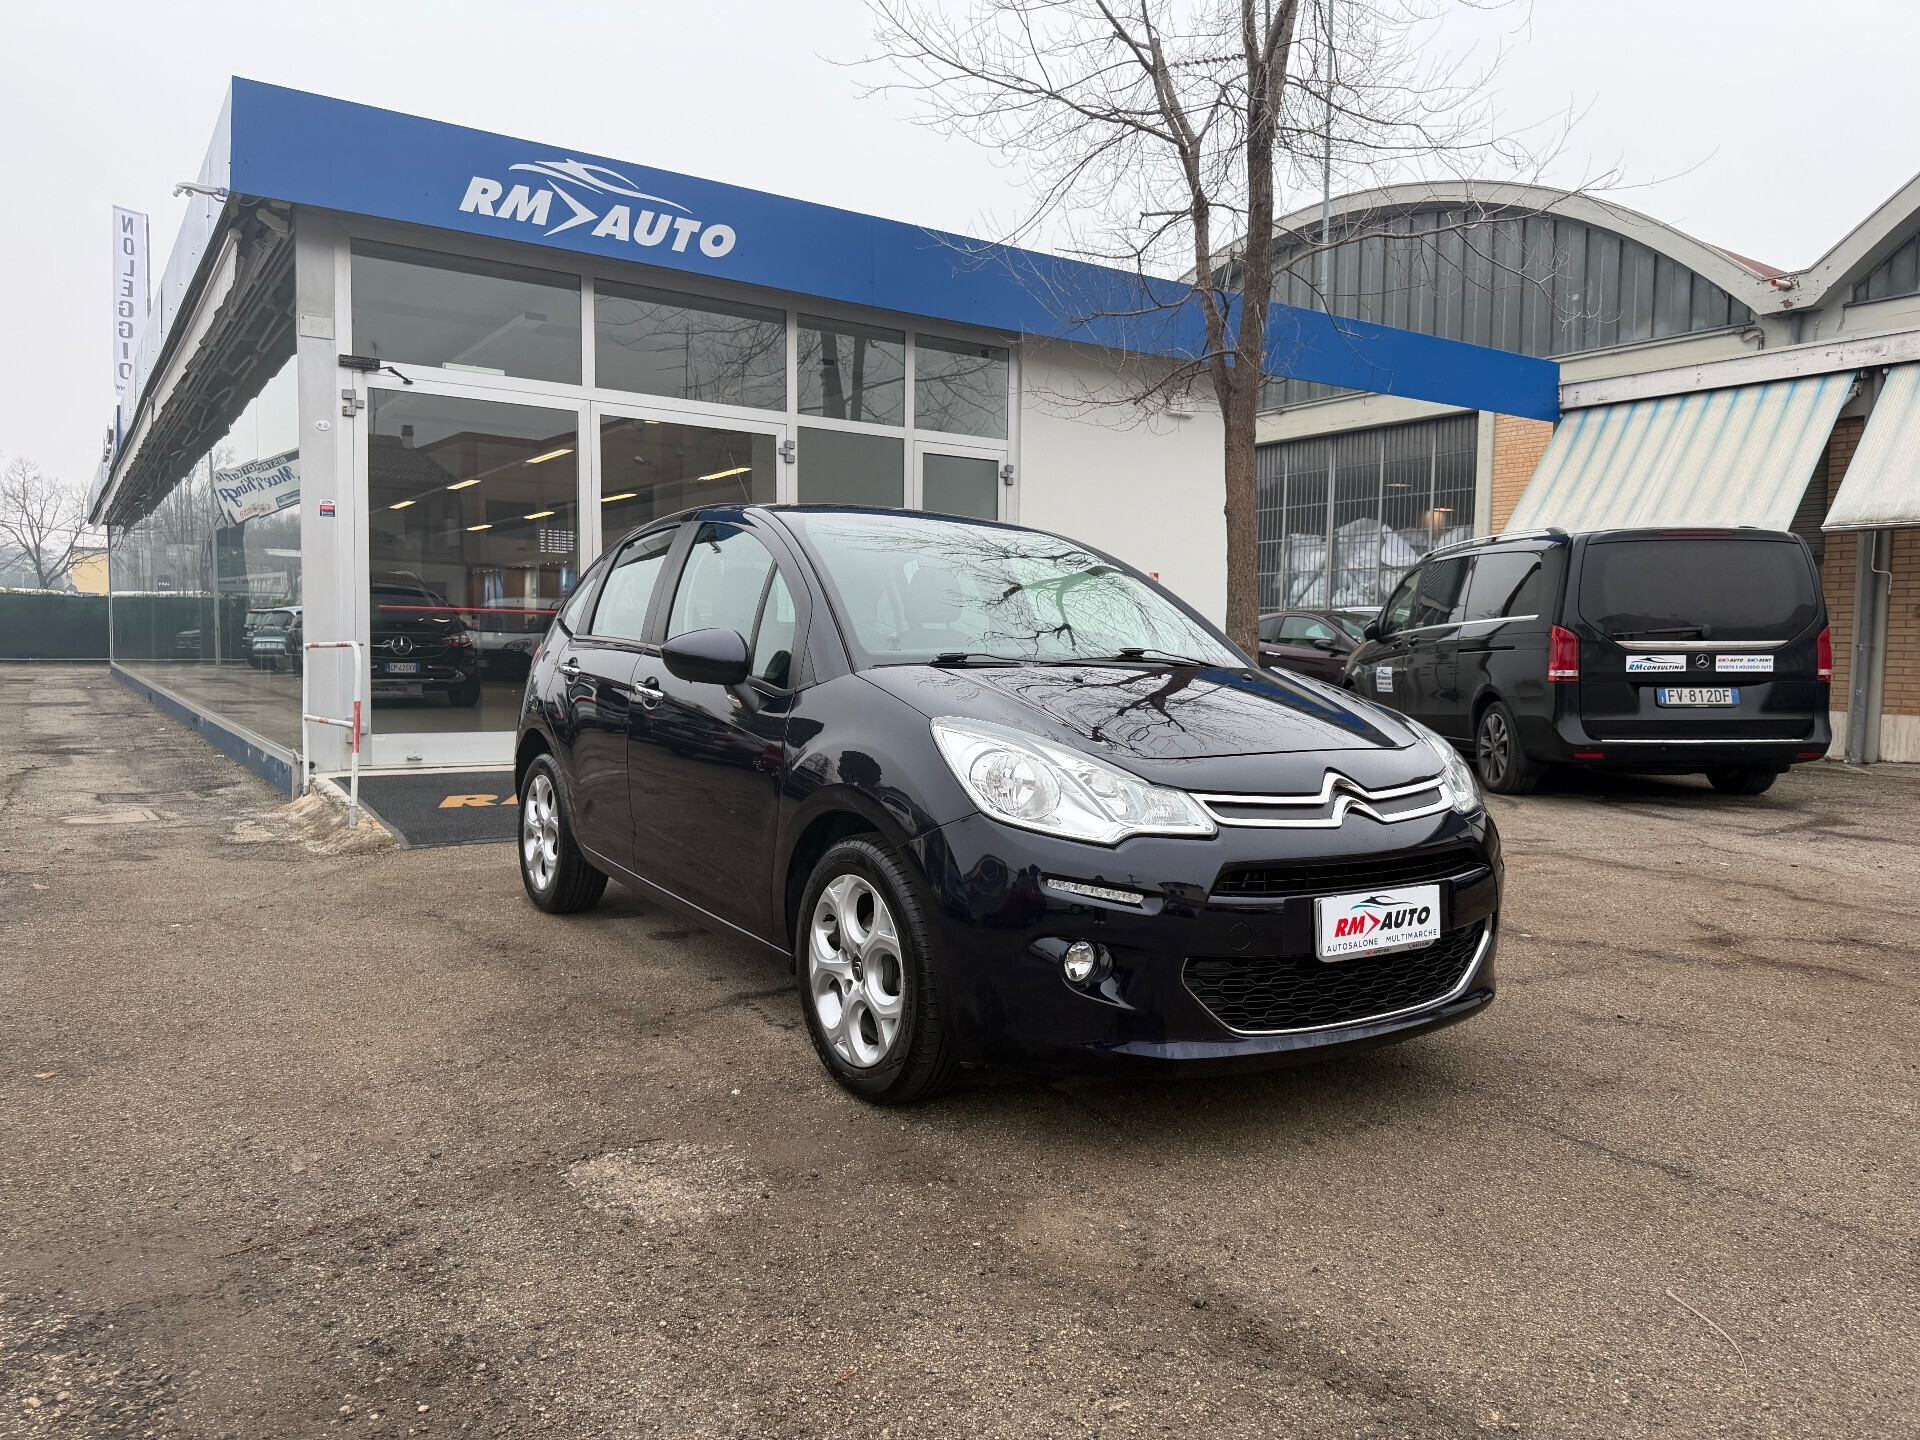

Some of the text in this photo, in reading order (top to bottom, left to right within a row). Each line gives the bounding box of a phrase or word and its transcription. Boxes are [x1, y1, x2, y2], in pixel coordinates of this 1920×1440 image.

[458, 176, 737, 258] RM AUTO
[1334, 906, 1431, 938] RM AUTO
[1327, 938, 1379, 953] AUTOSALONE
[1385, 928, 1438, 943] MULTIMARCHE
